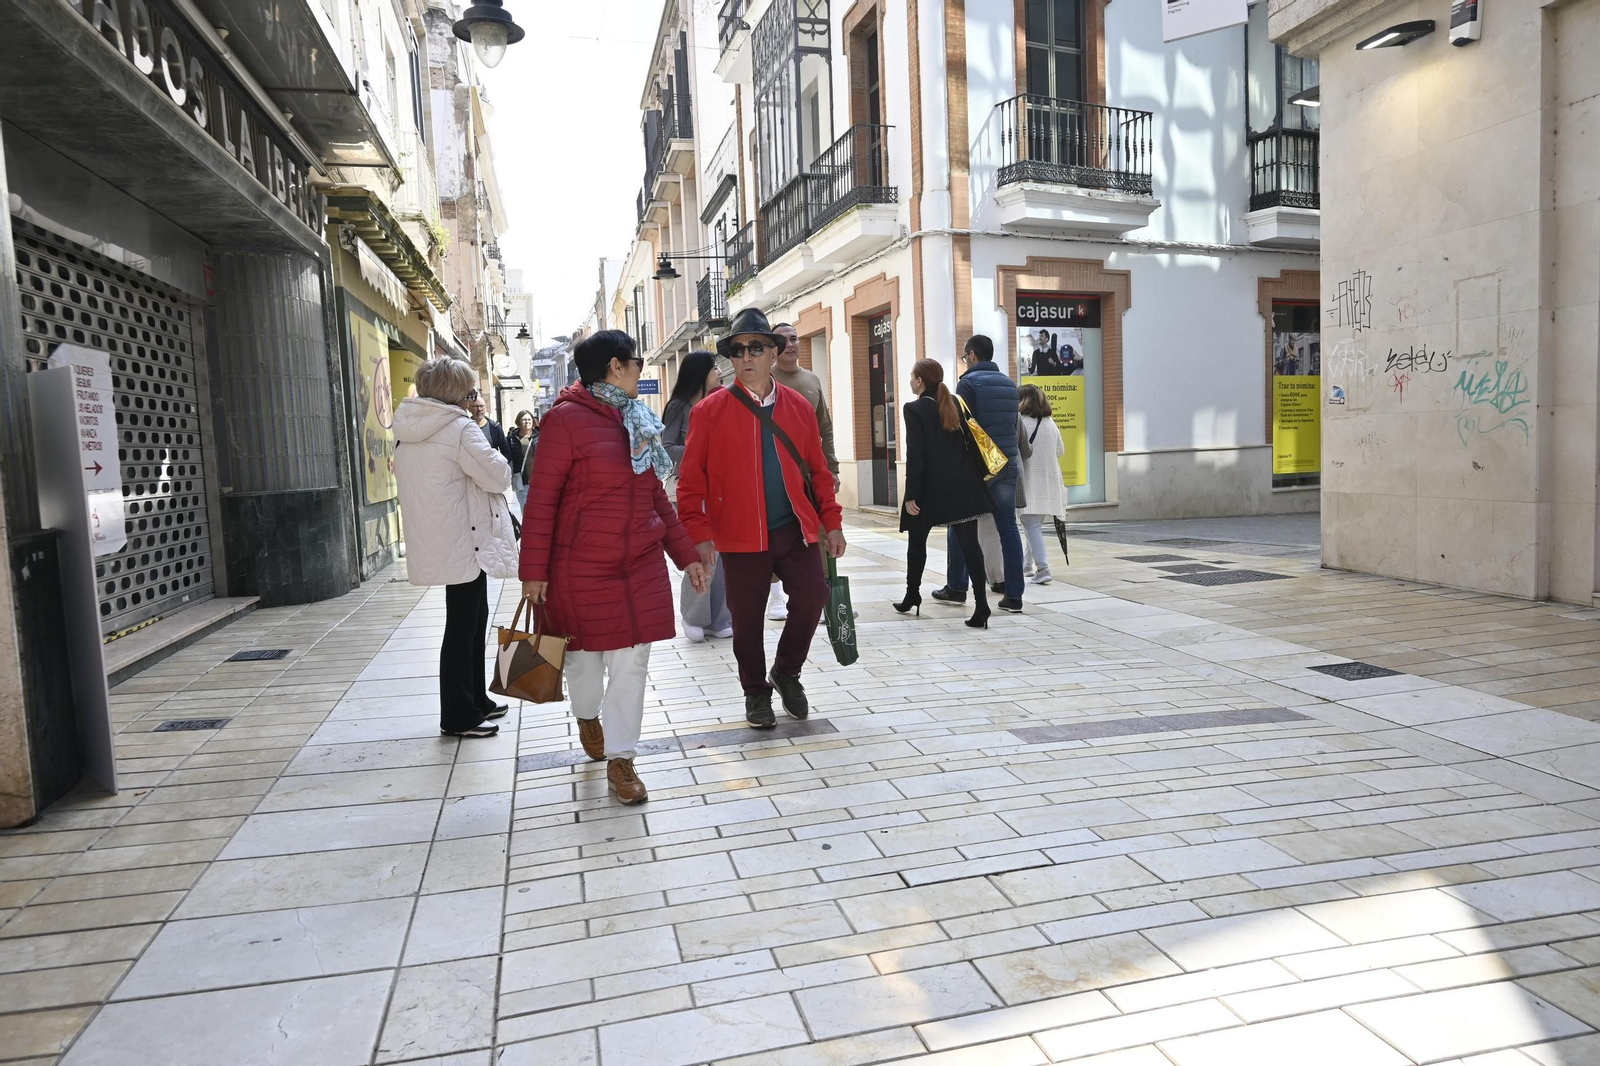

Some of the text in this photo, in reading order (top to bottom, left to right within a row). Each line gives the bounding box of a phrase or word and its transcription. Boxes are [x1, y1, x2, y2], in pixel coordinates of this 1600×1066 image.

[1167, 1, 1190, 9] Coworking
[1018, 302, 1074, 322] cajasur
[75, 377, 92, 388] SEGUIR
[1052, 382, 1078, 391] nómina:
[1296, 382, 1316, 390] nómina:
[84, 404, 103, 414] HELADOS
